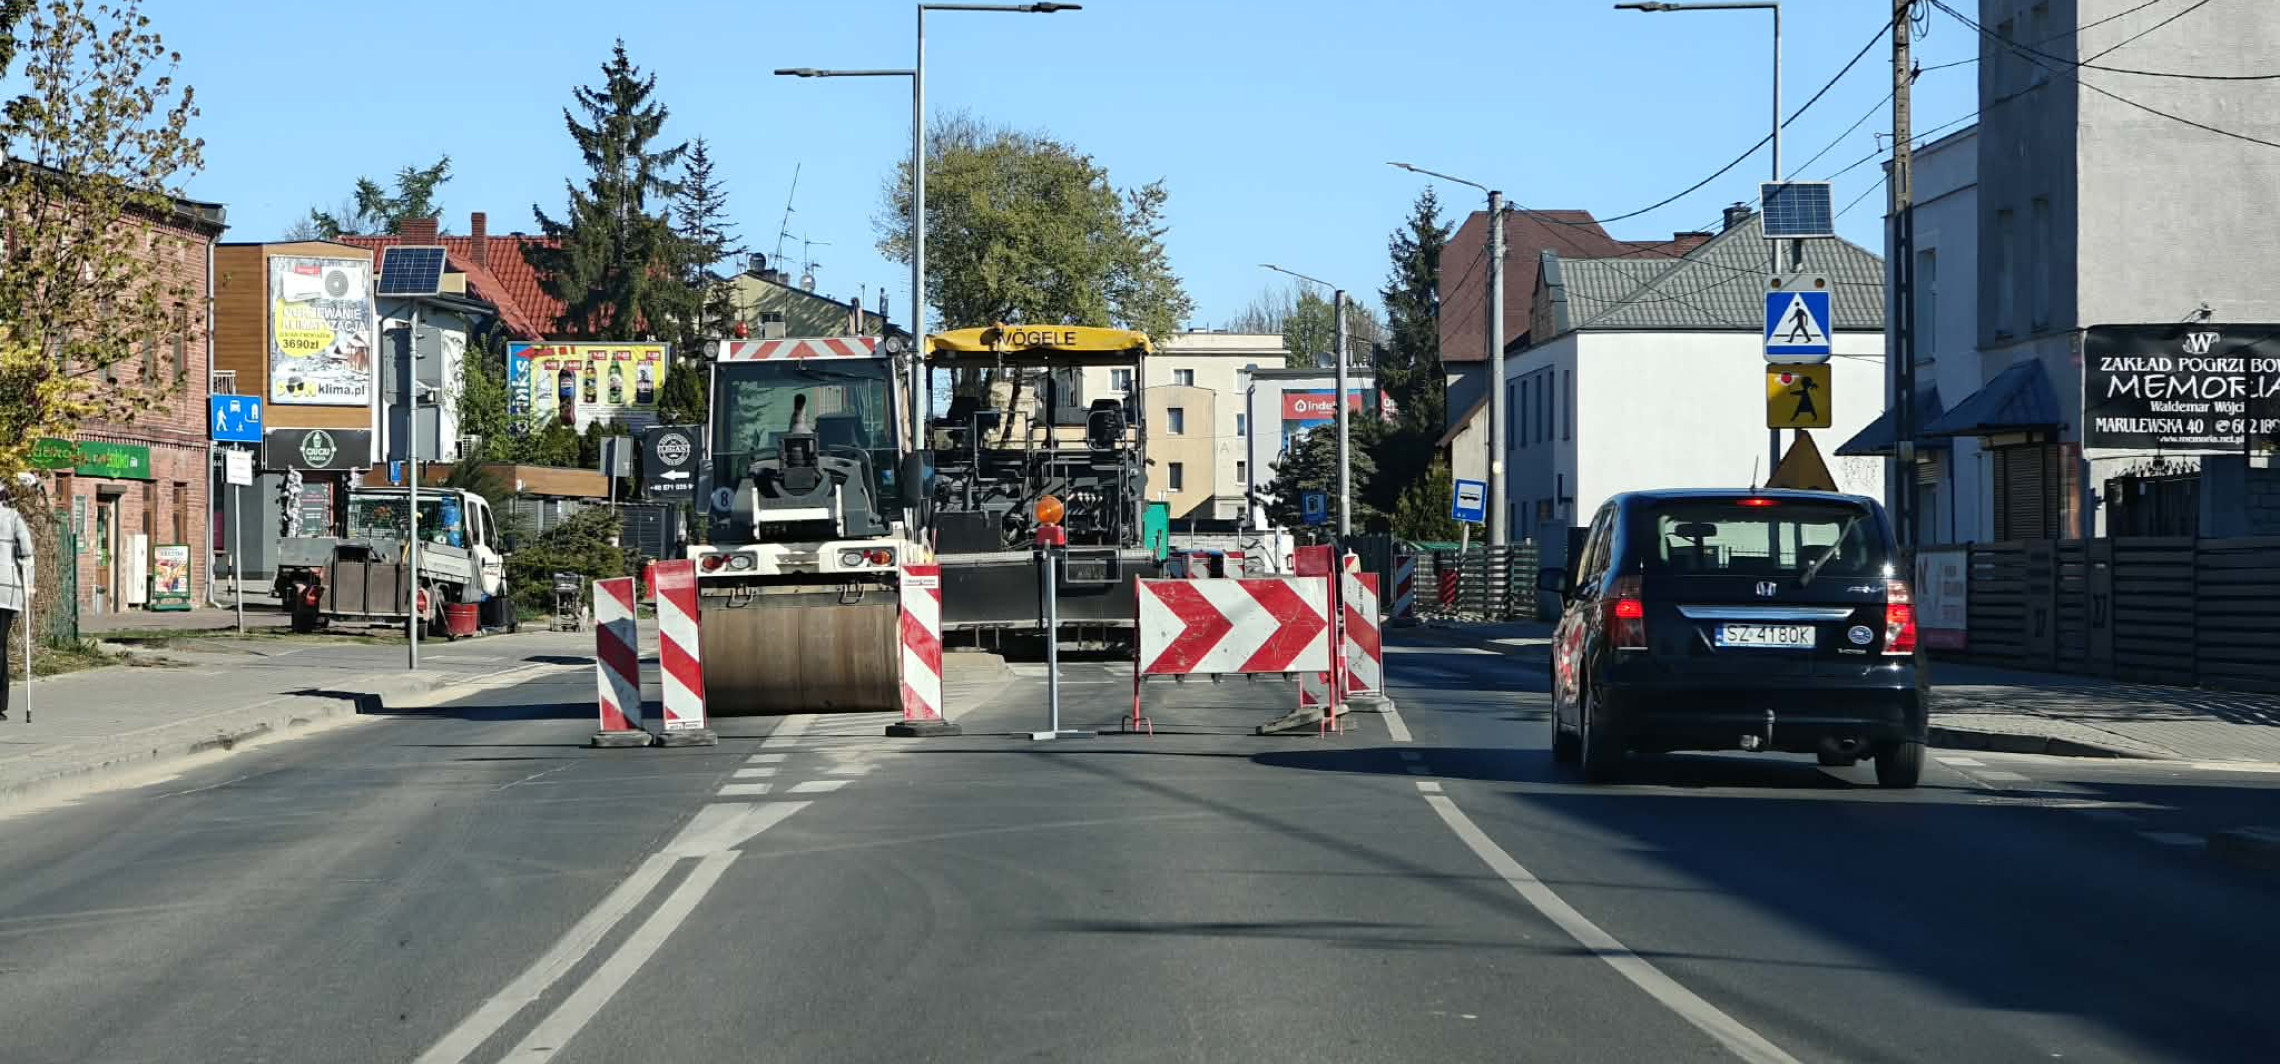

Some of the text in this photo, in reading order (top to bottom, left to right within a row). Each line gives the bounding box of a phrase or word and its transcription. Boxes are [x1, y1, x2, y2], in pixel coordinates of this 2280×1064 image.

[1001, 328, 1076, 346] VÖGELE
[2100, 357, 2172, 372] ZAKŁAD
[318, 382, 365, 398] klima.pl
[2151, 401, 2245, 416] Waldemar Wójci
[2096, 418, 2183, 433] MARULEWSKA
[2186, 418, 2204, 434] 40
[721, 491, 729, 507] 8
[1727, 625, 1809, 644] SZ 4180K
